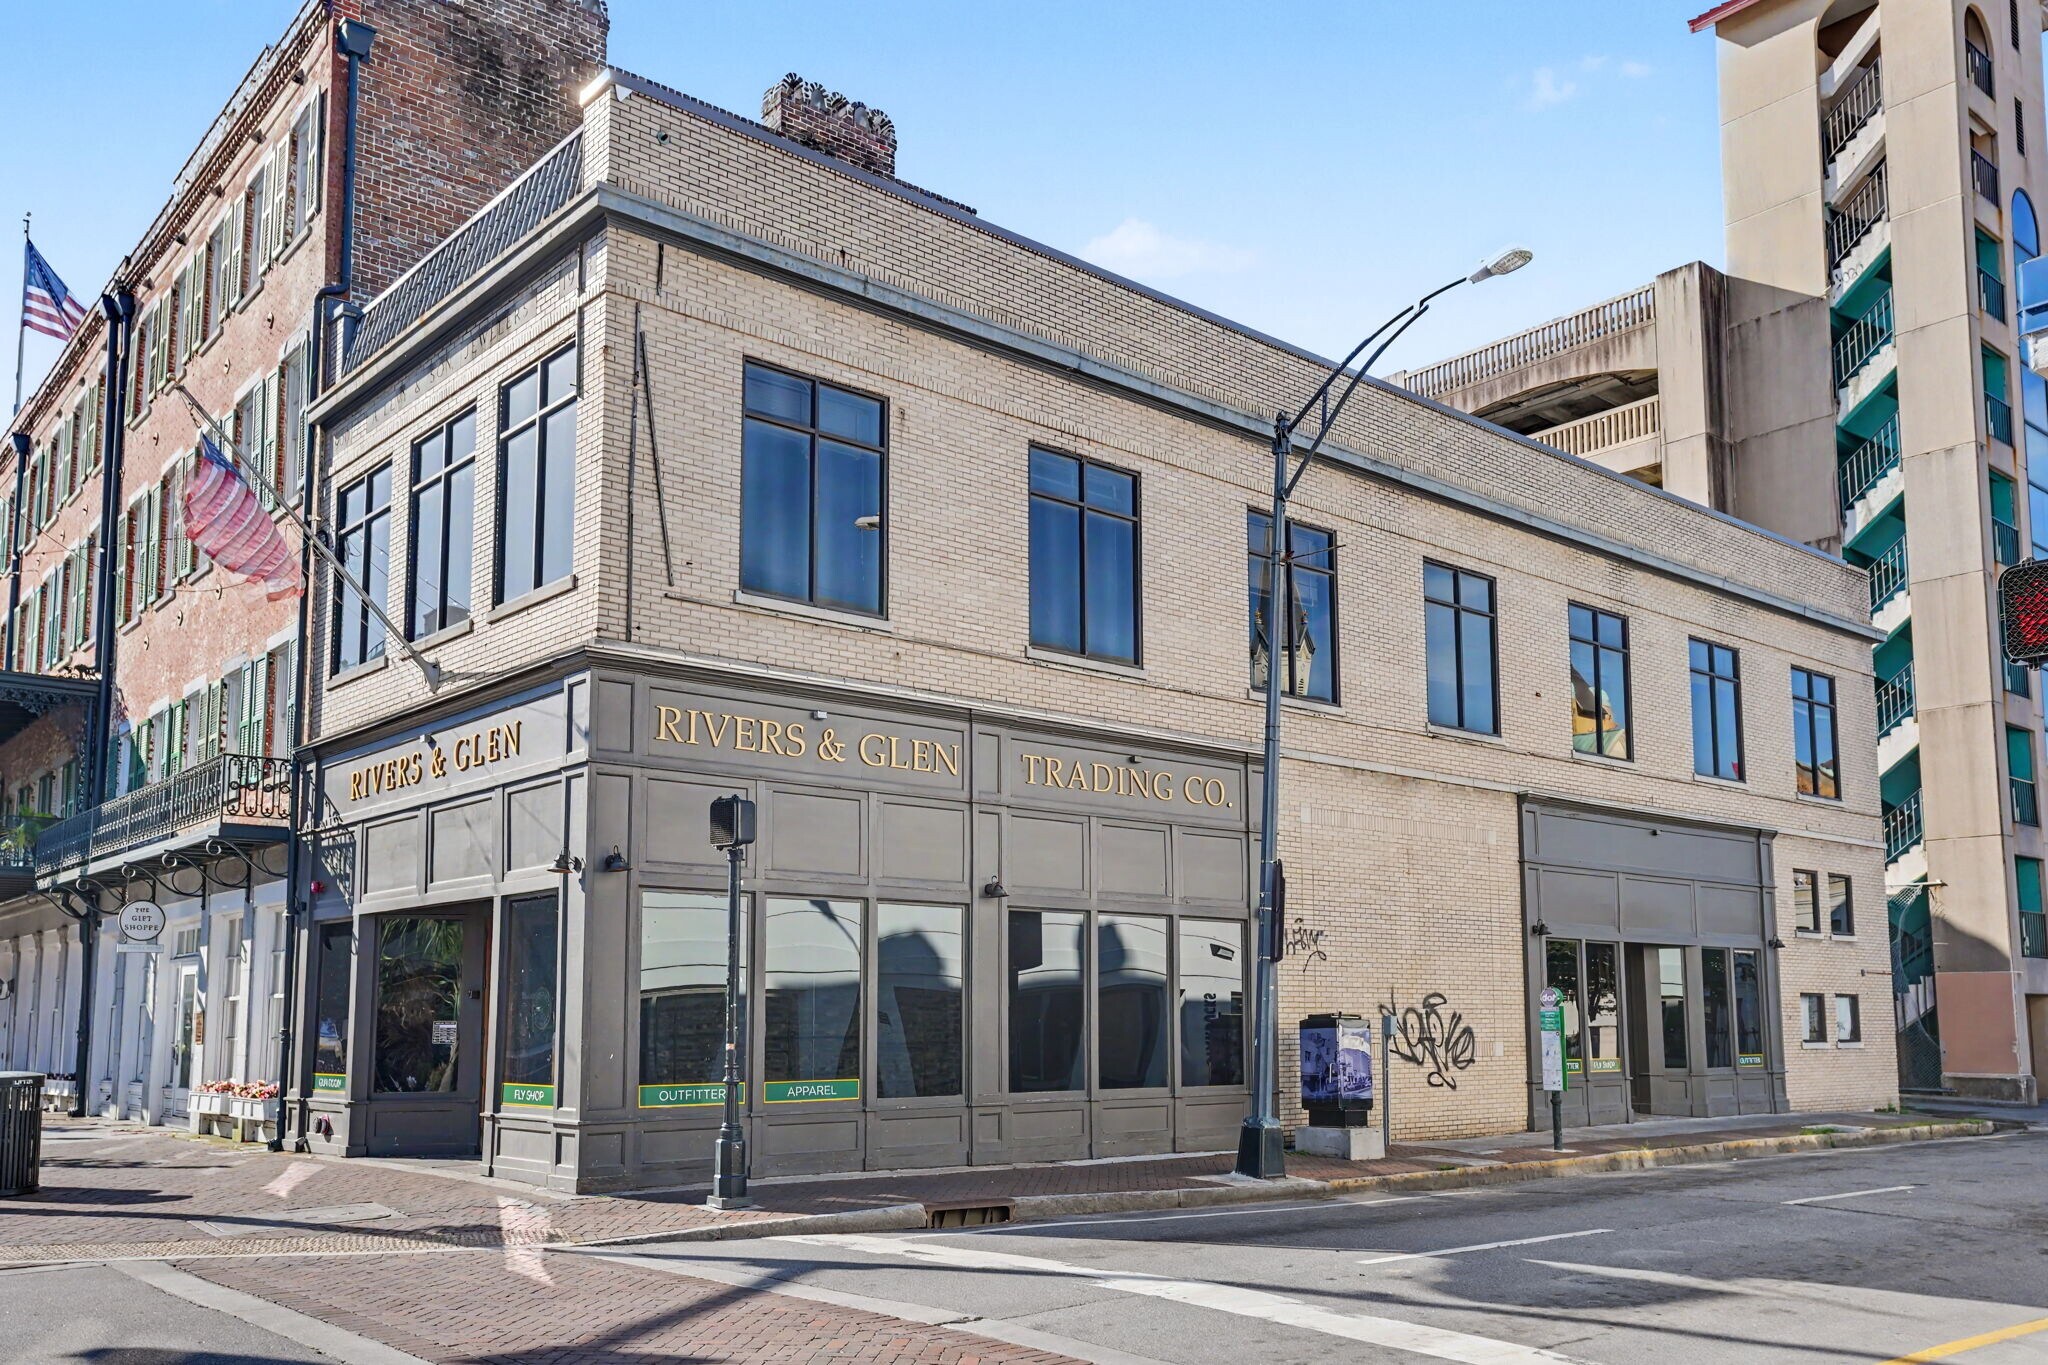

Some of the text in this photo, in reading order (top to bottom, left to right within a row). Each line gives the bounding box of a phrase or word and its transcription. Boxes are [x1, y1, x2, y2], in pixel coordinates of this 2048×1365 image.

[655, 705, 959, 776] RIVERS & GLEN
[350, 719, 522, 801] RIVERS & GLEN
[1021, 754, 1233, 808] TRADING CO.
[514, 1089, 544, 1101] FLY SHOP
[658, 1088, 726, 1101] OUTFITTER
[787, 1085, 837, 1097] APPAREL
